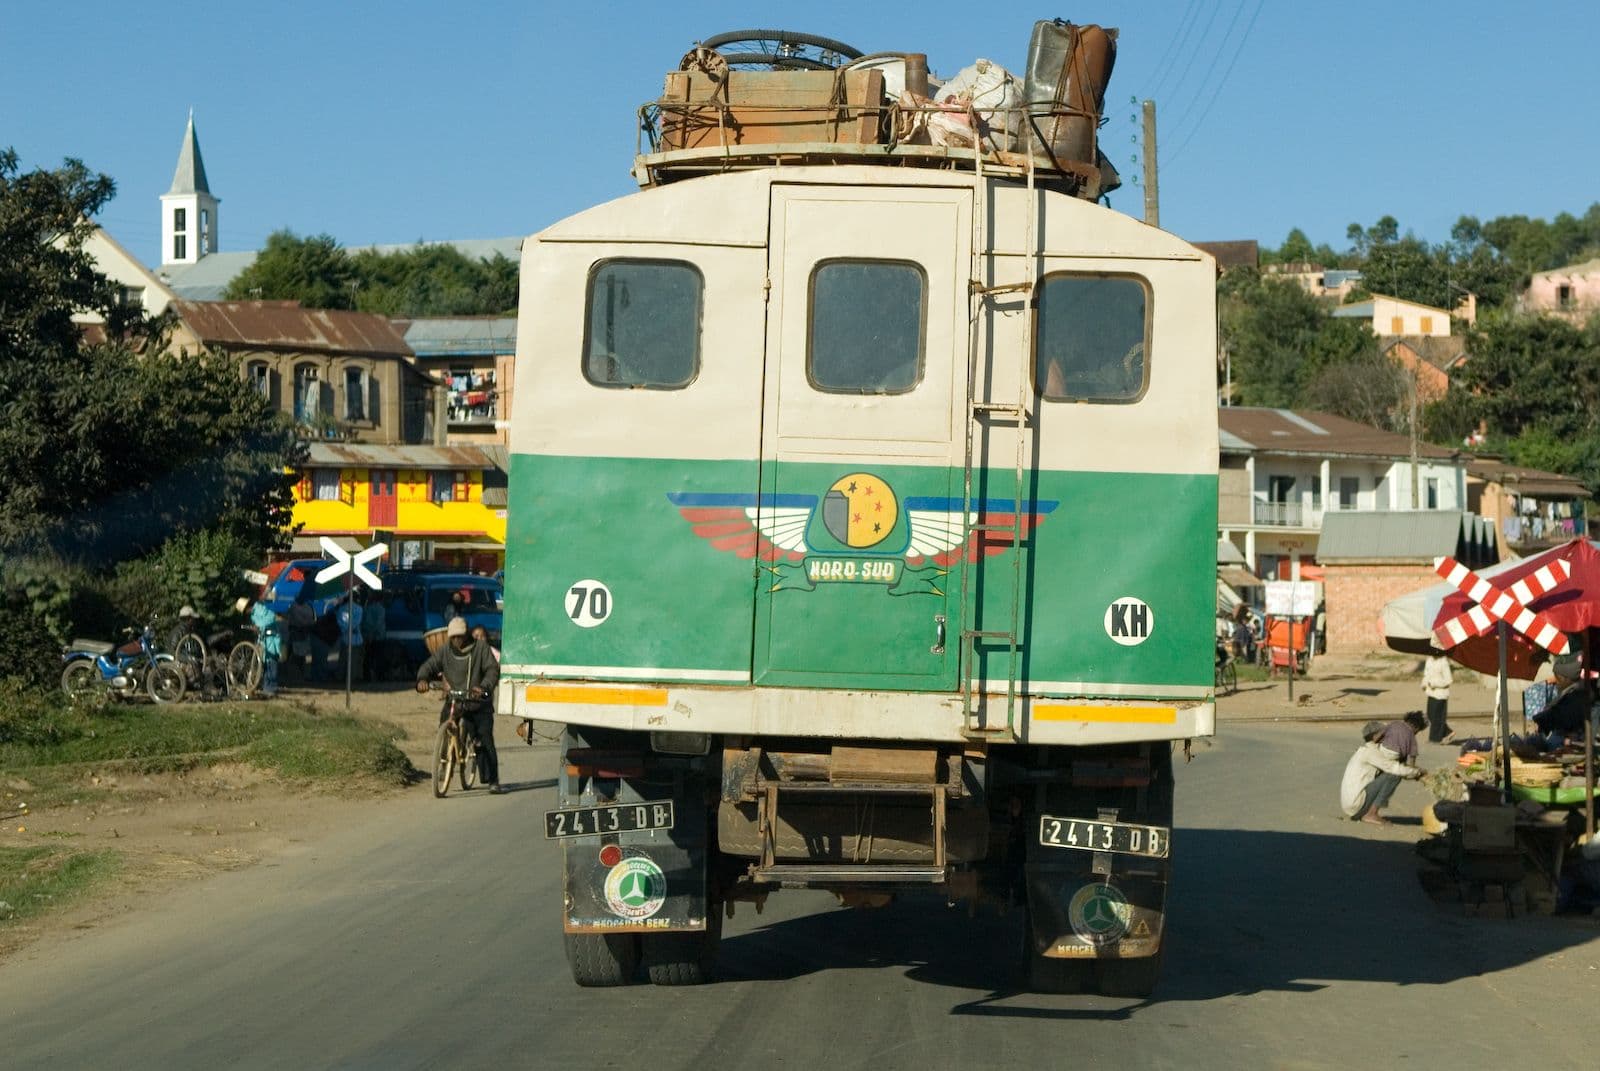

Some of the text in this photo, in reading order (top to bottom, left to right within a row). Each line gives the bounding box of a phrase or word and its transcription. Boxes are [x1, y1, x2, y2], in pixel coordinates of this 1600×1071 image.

[809, 560, 895, 581] NORD-SUD
[570, 587, 607, 619] 70
[1111, 603, 1147, 637] KH
[555, 804, 665, 836] 2413 DB
[1049, 820, 1158, 854] 2413 DB
[646, 917, 671, 928] BENZ
